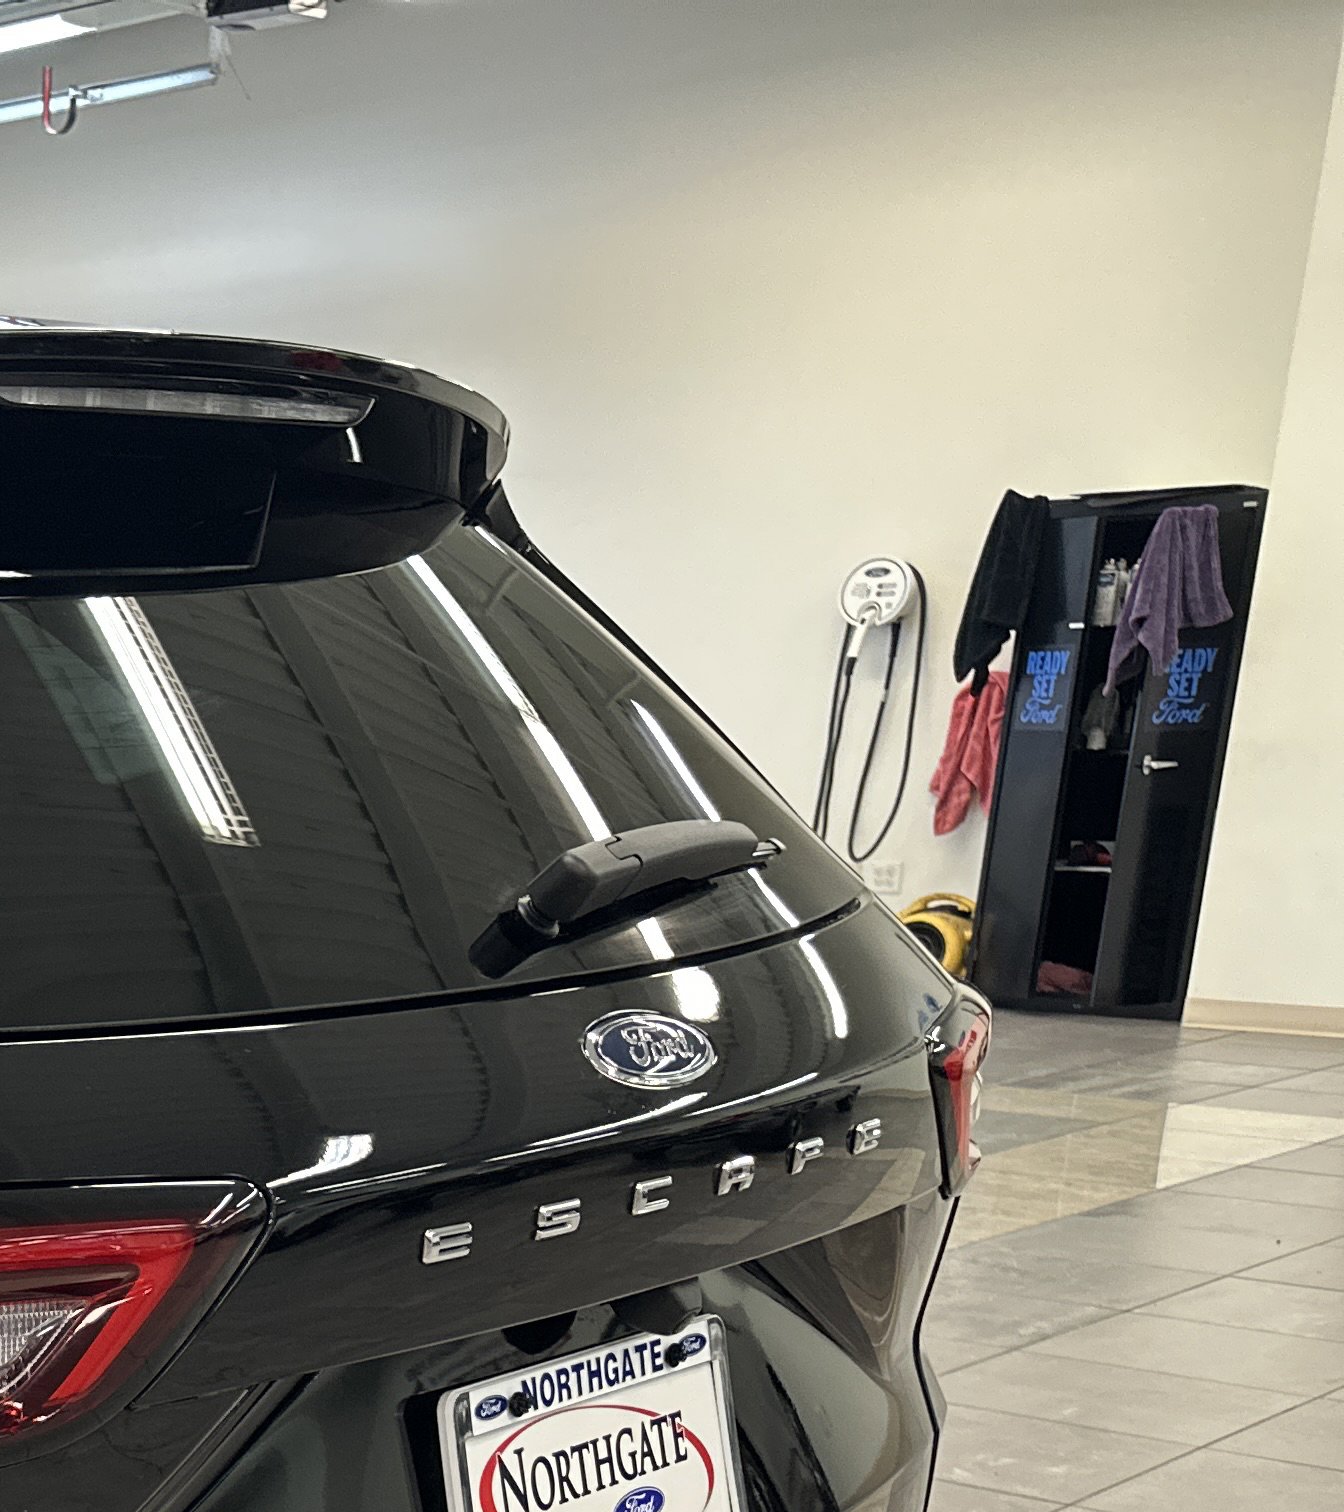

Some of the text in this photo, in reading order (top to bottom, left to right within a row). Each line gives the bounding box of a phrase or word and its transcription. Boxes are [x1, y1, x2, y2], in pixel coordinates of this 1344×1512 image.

[1026, 650, 1071, 676] READY
[1032, 673, 1058, 698] SET
[1167, 672, 1203, 698] SET
[1020, 697, 1062, 724] Ford
[1152, 697, 1204, 725] Ford
[620, 1023, 697, 1069] Ford
[421, 1117, 883, 1266] ESCAPE
[520, 1338, 664, 1412] NORTHGATE
[477, 1396, 505, 1419] Ford
